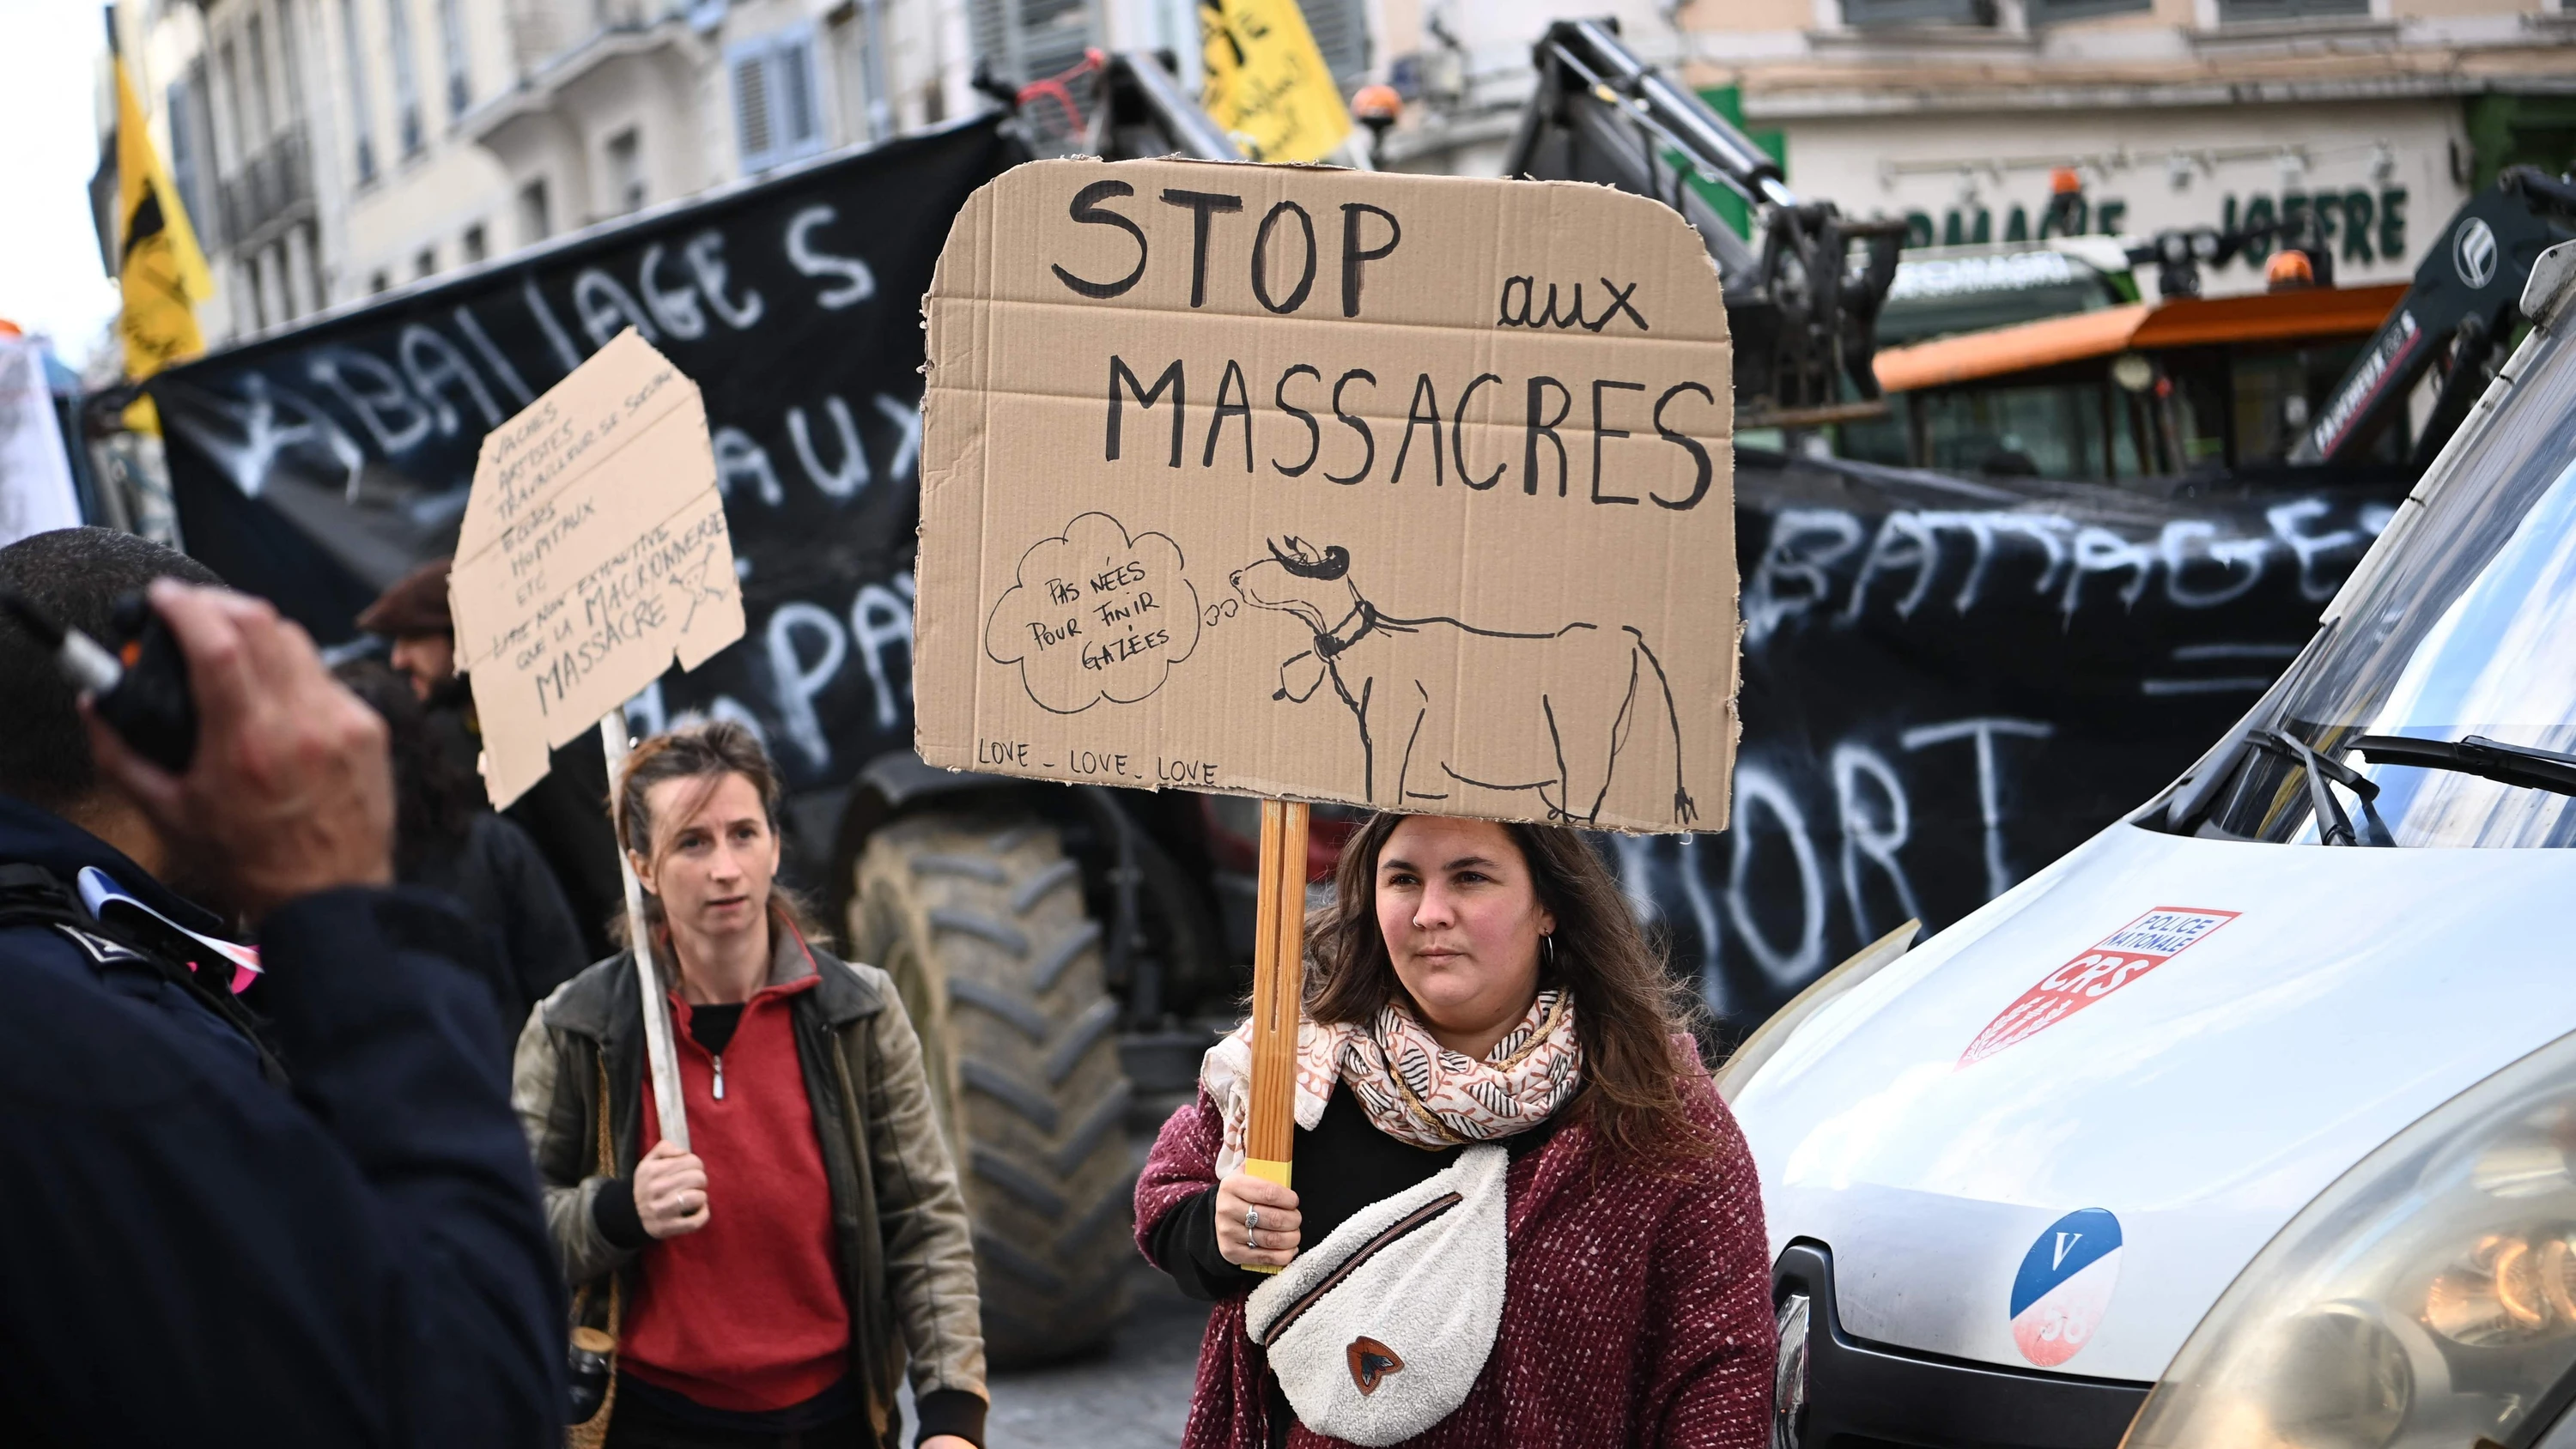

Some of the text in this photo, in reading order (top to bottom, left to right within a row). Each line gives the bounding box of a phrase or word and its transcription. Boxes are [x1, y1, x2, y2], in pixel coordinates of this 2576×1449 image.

[1051, 179, 1649, 332] STOP aux
[490, 400, 558, 464] VACHES
[1104, 355, 1715, 510] MASSACRES
[1045, 555, 1145, 606] PAS NÉES
[515, 640, 546, 671] QUE
[555, 617, 574, 643] LA
[535, 592, 667, 718] MASSACRE
[1025, 618, 1082, 652] POUR
[1081, 623, 1170, 671] GAZÉES
[978, 737, 1030, 767] LOVE
[1070, 749, 1128, 776] LOVE
[1157, 756, 1218, 785] LOVE
[2101, 931, 2195, 953] NATIONALE
[2135, 915, 2215, 935] POLICE
[2039, 954, 2150, 997] CRS
[2052, 1232, 2084, 1272] V
